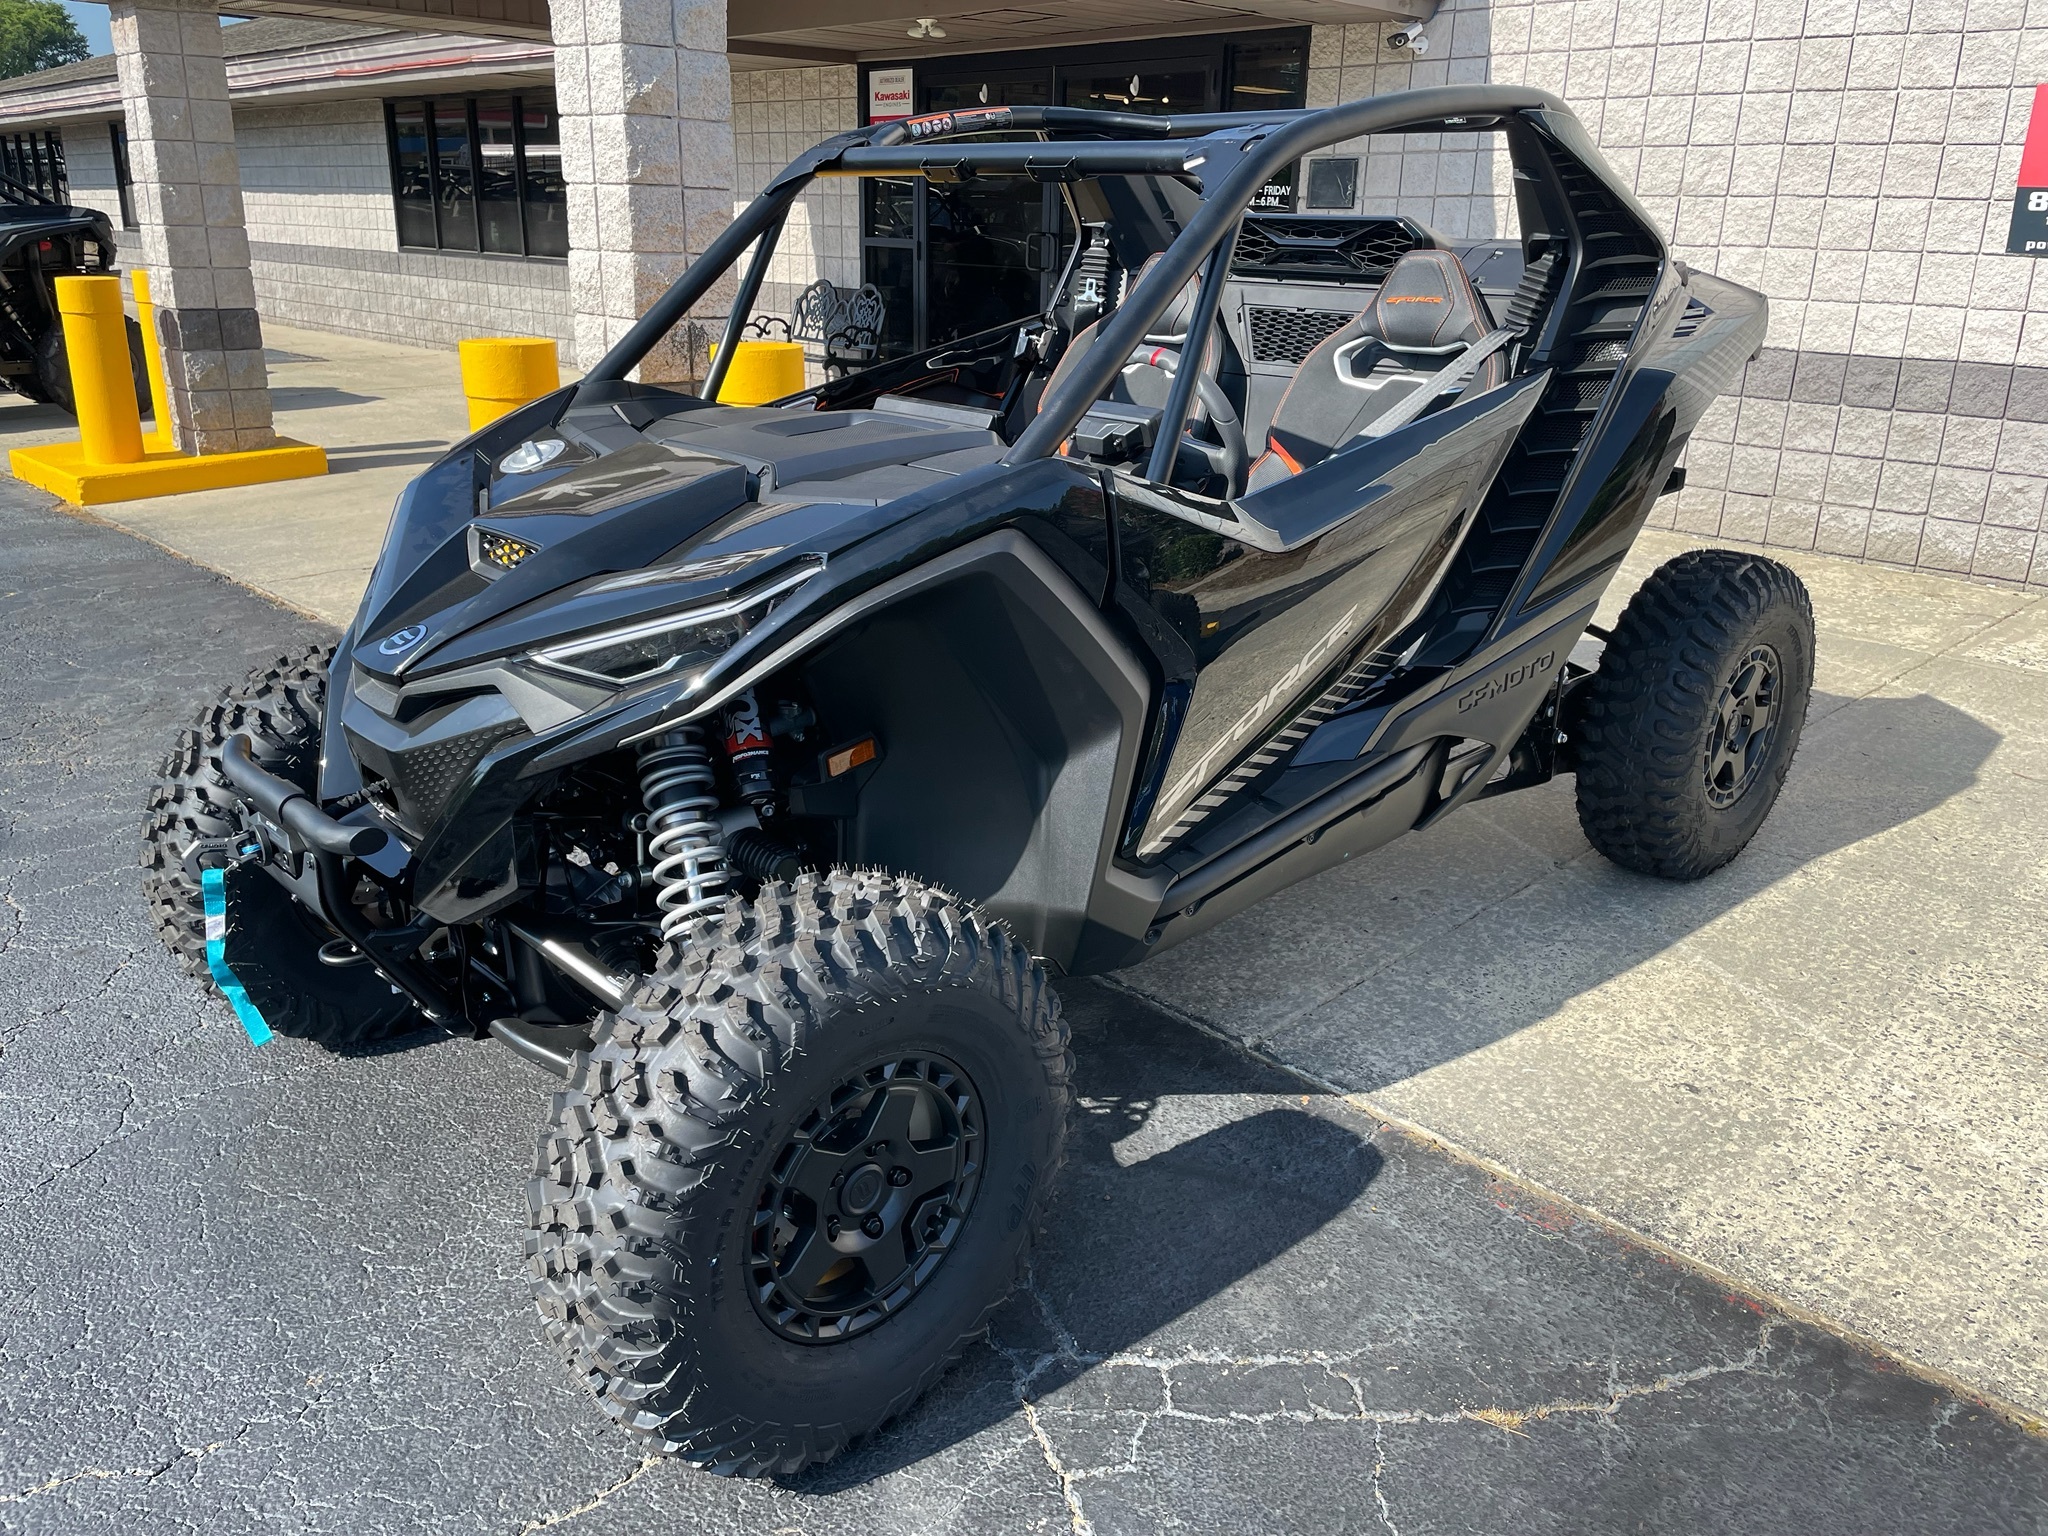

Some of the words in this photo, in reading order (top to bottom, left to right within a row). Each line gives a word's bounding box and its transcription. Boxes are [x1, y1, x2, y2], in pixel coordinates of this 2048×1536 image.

[874, 90, 910, 101] Kawasaki
[1263, 185, 1291, 196] FRIDAY
[2025, 240, 2048, 252] po
[1458, 650, 1555, 714] CFMOTO
